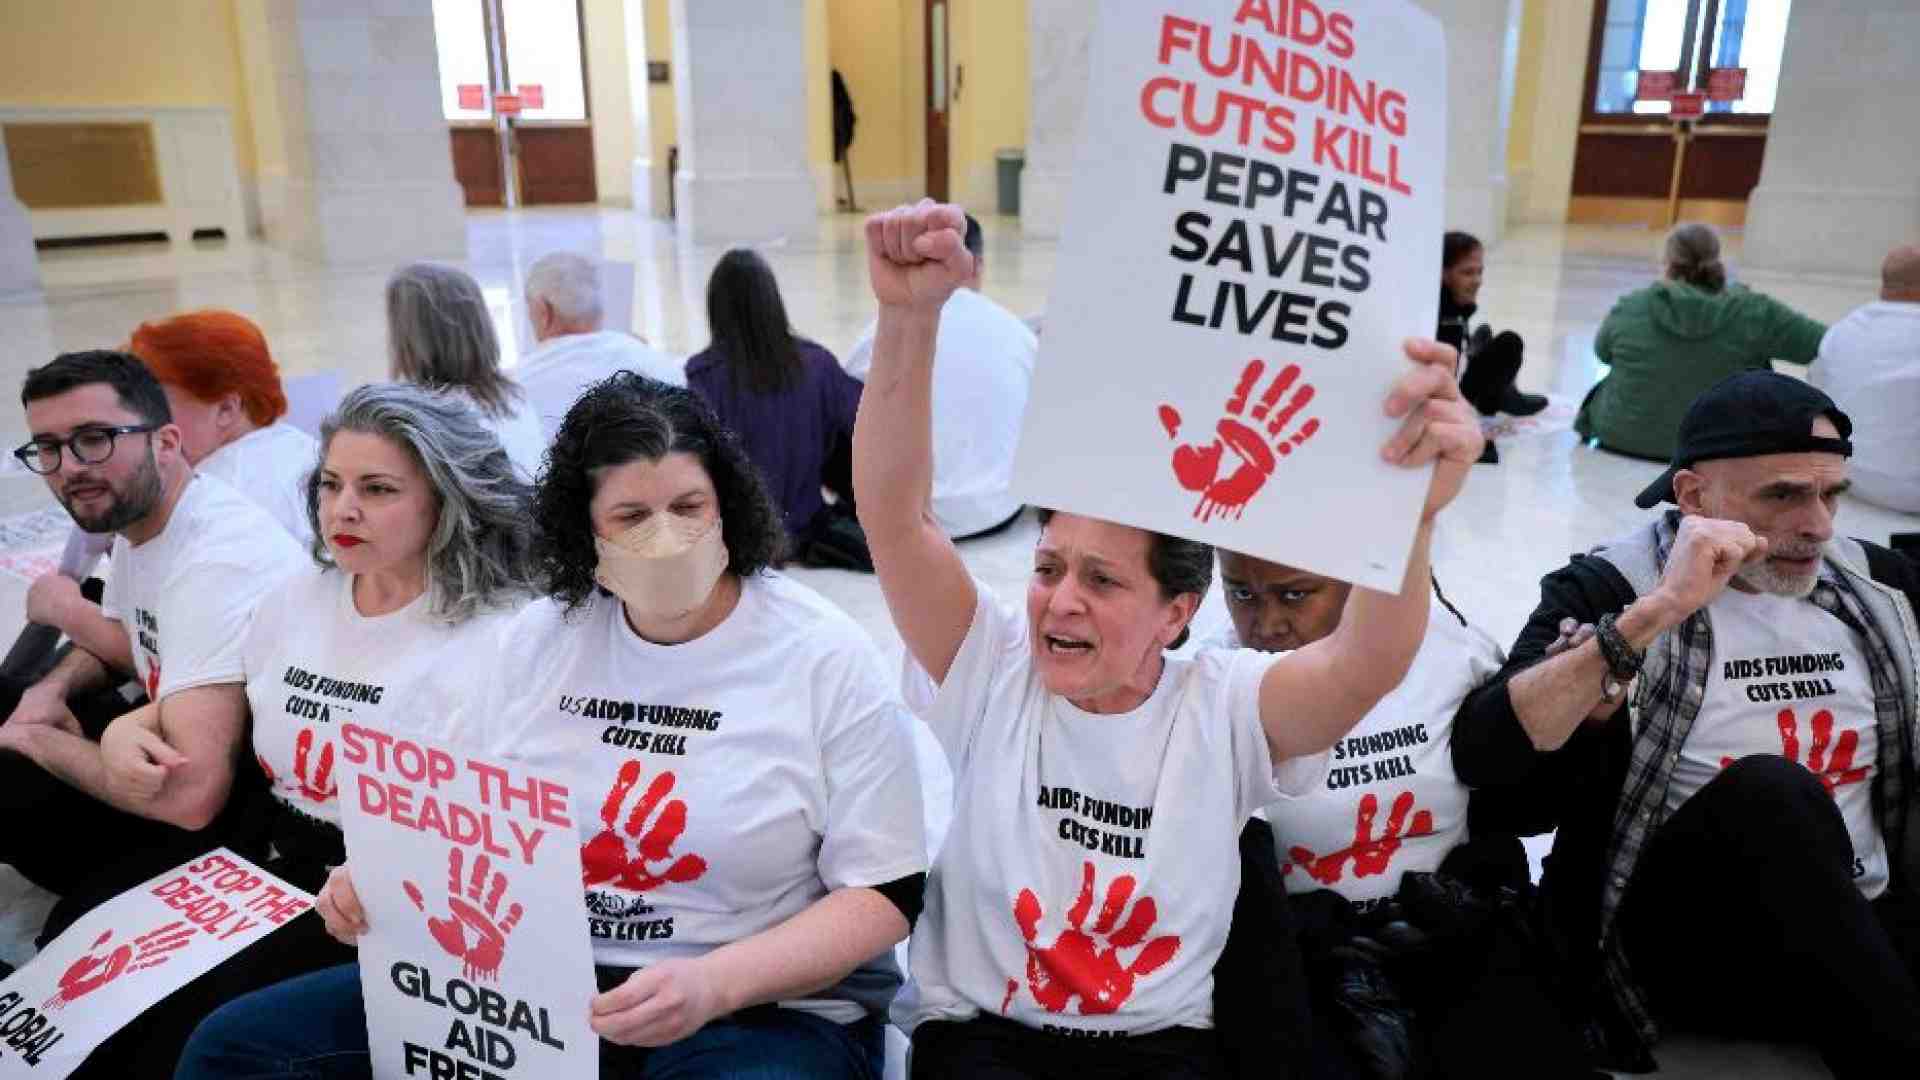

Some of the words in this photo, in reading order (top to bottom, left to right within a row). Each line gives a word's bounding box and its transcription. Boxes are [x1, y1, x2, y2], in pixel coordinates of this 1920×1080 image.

[1235, 0, 1356, 59] AIDS
[1158, 15, 1408, 137] FUNDING
[1140, 77, 1297, 155] CUTS
[1313, 118, 1412, 197] KILL
[1163, 143, 1390, 243] PEPFAR
[1169, 211, 1373, 293] SAVES
[1172, 274, 1352, 351] LIVES
[313, 676, 384, 705] FUNDING
[1724, 658, 1763, 680] AIDS
[1765, 653, 1845, 676] FUNDING
[1746, 683, 1793, 702] CUTS
[1792, 679, 1836, 699] KILL
[602, 725, 652, 751] CUTS
[650, 733, 688, 756] KILL
[637, 704, 723, 731] FUNDING
[1347, 723, 1429, 758] FUNDING
[341, 723, 456, 789] STOP
[467, 760, 572, 828] THE
[1327, 764, 1373, 790] CUTS
[1374, 754, 1417, 781] KILL
[357, 773, 545, 865] DEADLY
[1082, 795, 1153, 829] FUNDIN
[1100, 831, 1145, 858] KILL
[151, 876, 259, 941] DEADLY
[188, 855, 263, 894] STOP
[245, 885, 313, 924] THE
[616, 917, 674, 941] LIVES
[391, 960, 566, 1051] GLOBAL
[403, 1041, 508, 1080] FRE
[445, 1018, 517, 1070] AID
